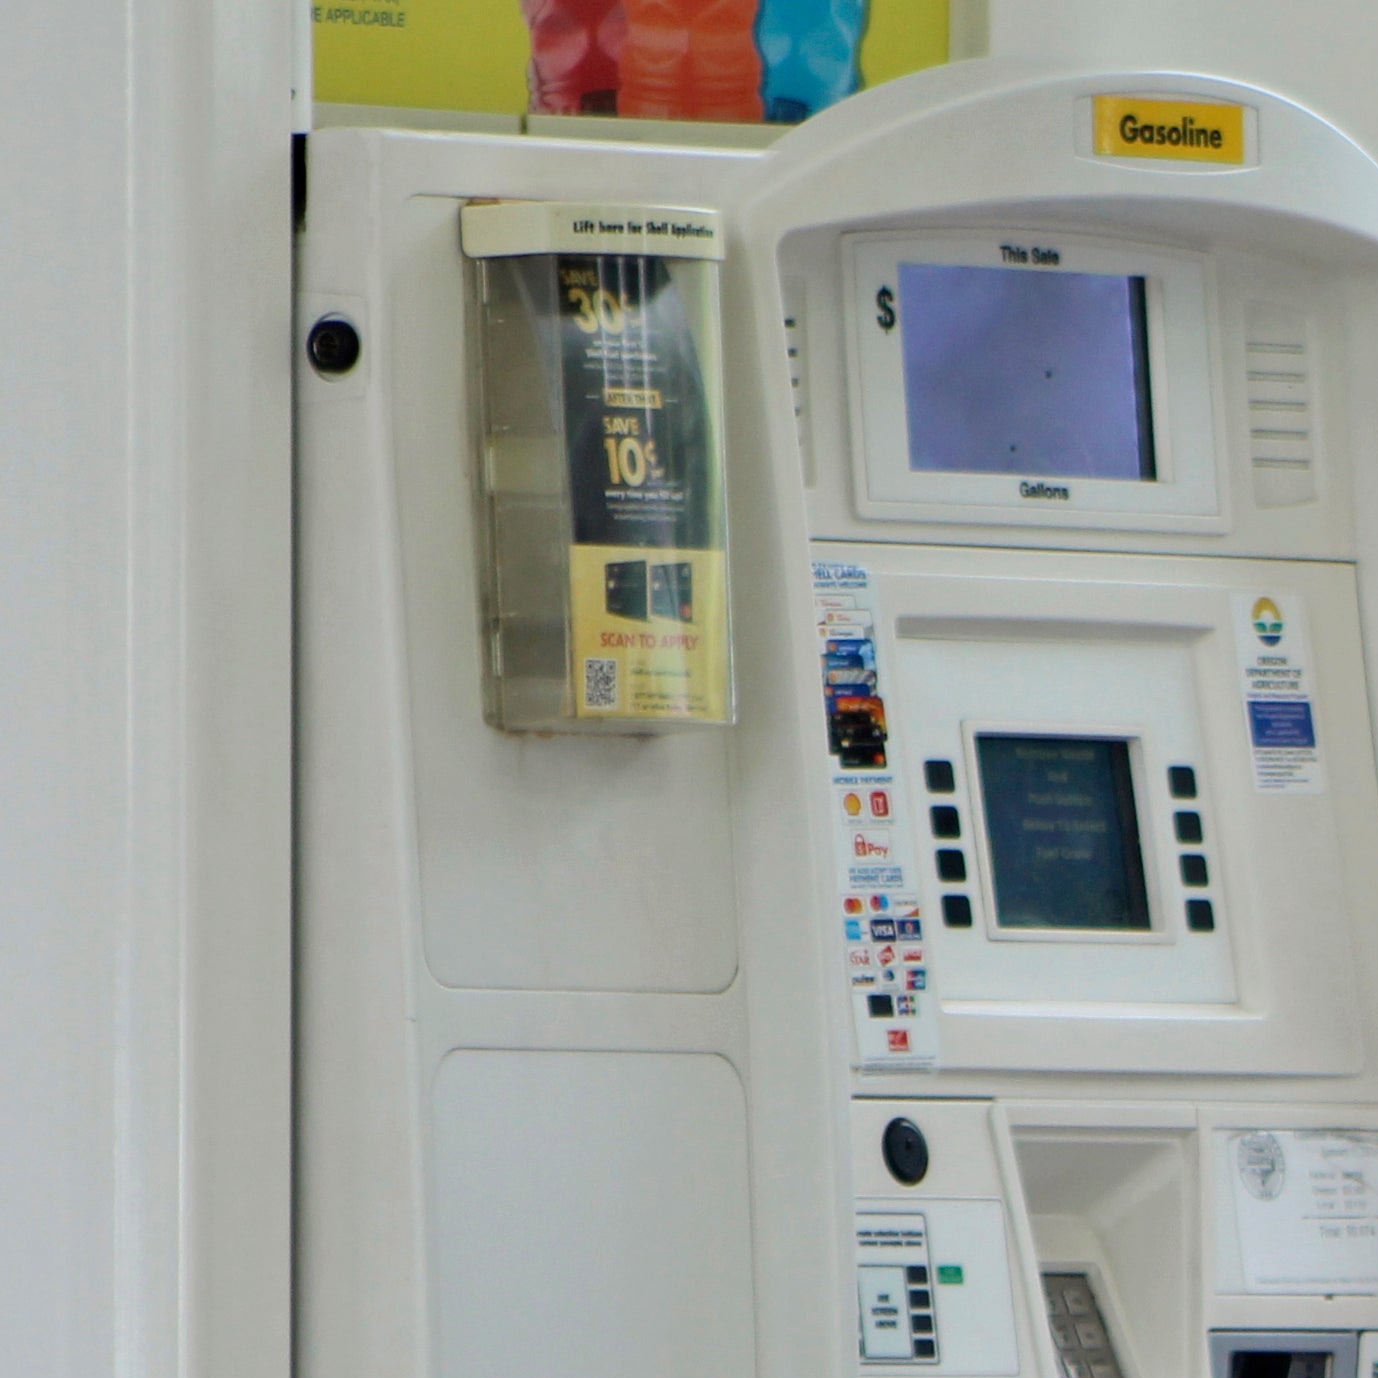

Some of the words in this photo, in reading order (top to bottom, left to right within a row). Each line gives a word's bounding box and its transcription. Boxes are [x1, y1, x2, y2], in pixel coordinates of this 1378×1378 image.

[326, 8, 405, 27] APPLICABLE
[1119, 114, 1223, 149] Gasoline
[573, 221, 594, 234] Lift
[1000, 245, 1028, 264] This
[1032, 247, 1059, 265] Sale
[876, 285, 896, 334] $
[603, 416, 640, 436] SAVE
[1019, 481, 1069, 500] Gallons
[600, 632, 635, 648] SCAN
[640, 633, 656, 649] TO
